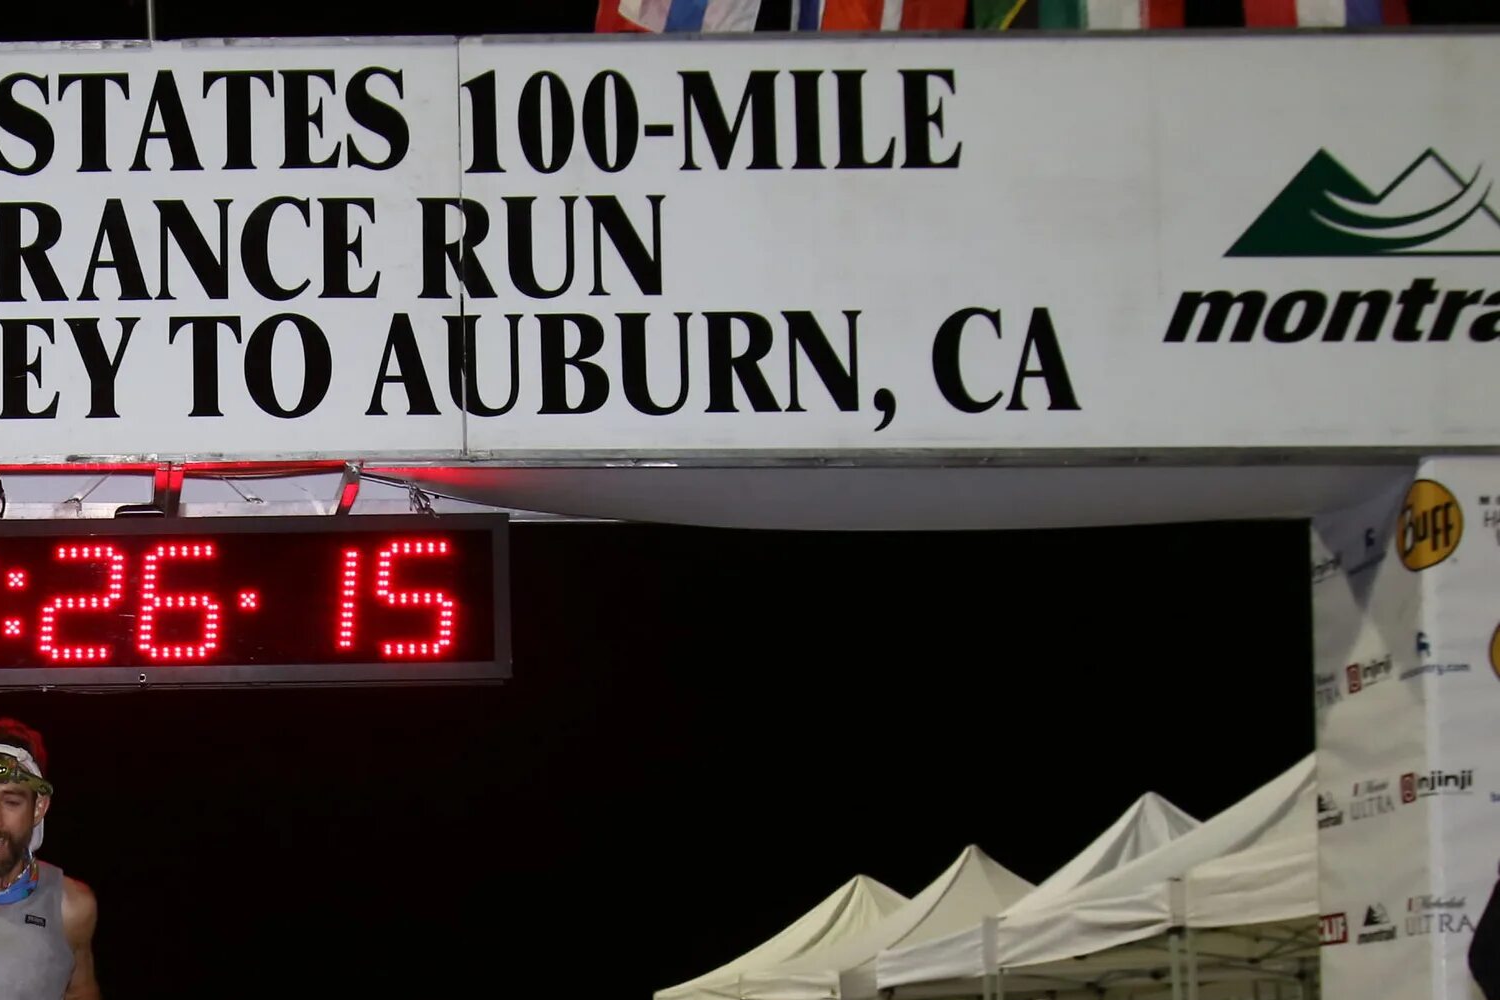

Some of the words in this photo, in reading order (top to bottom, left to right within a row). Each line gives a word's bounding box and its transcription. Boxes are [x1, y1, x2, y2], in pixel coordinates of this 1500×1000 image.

[462, 68, 964, 175] 100-MILE
[418, 194, 667, 301] RUN
[170, 312, 332, 418] TO
[365, 308, 897, 433] AUBURN,
[931, 305, 1081, 413] CA
